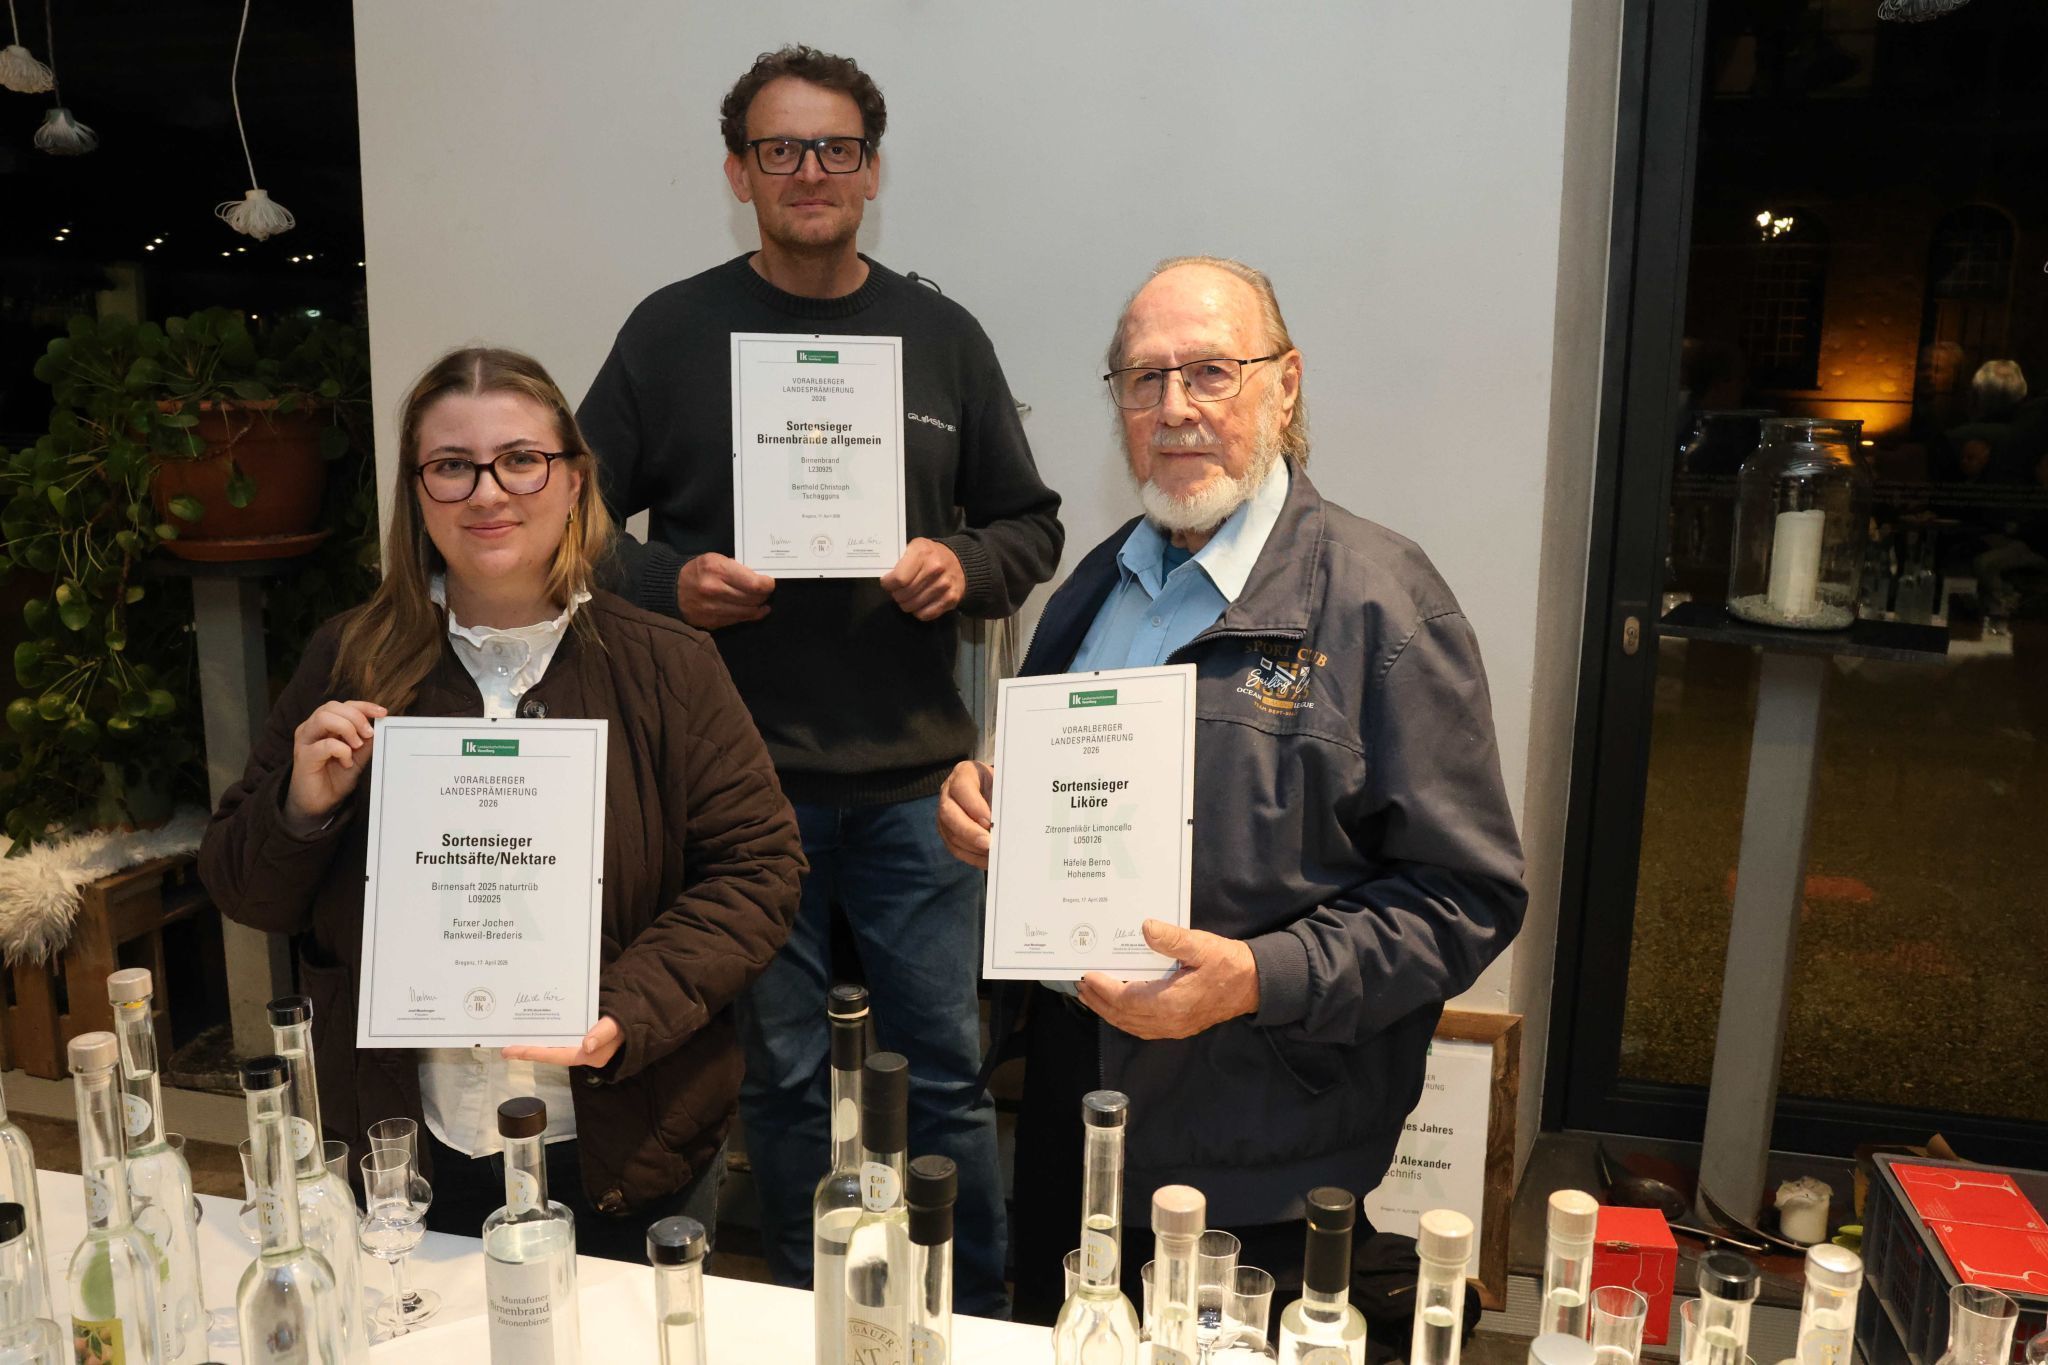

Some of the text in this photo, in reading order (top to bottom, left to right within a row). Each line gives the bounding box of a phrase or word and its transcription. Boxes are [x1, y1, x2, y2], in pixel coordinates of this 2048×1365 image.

[787, 421, 852, 433] Sortensieger
[758, 434, 881, 446] Birnenbrände allgemein
[821, 484, 850, 492] Christoph
[803, 493, 839, 501] Tschagguns
[1062, 723, 1123, 734] VORARLBERGER
[1051, 733, 1133, 746] LANDESPRÄMIERUNG
[1083, 746, 1100, 754] 2026
[454, 776, 525, 785] VORARLBERGER
[440, 786, 537, 796] LANDESPRÄMIERUNG
[1052, 779, 1129, 793] Sortensieger
[479, 799, 498, 807] 2026
[1071, 796, 1108, 808] Liköre
[1045, 824, 1132, 834] Zitronenlikör Limoncello
[442, 833, 532, 850] Sortensieger
[1074, 836, 1102, 844] L050126
[416, 851, 556, 865] Fruchtsäfte/Nektare
[1064, 858, 1110, 867] Häfele Berno
[1068, 870, 1105, 878] Hohenems
[432, 882, 538, 891] Birnensaft 2025 naturtrüb
[468, 895, 501, 904] L092025
[453, 919, 514, 927] Furxer Jochen
[444, 931, 522, 940] Rankweil-Brederis
[1403, 1119, 1454, 1135] es Jahres
[1401, 1156, 1452, 1169] Alexander
[498, 1317, 550, 1327] Zitronenbirne
